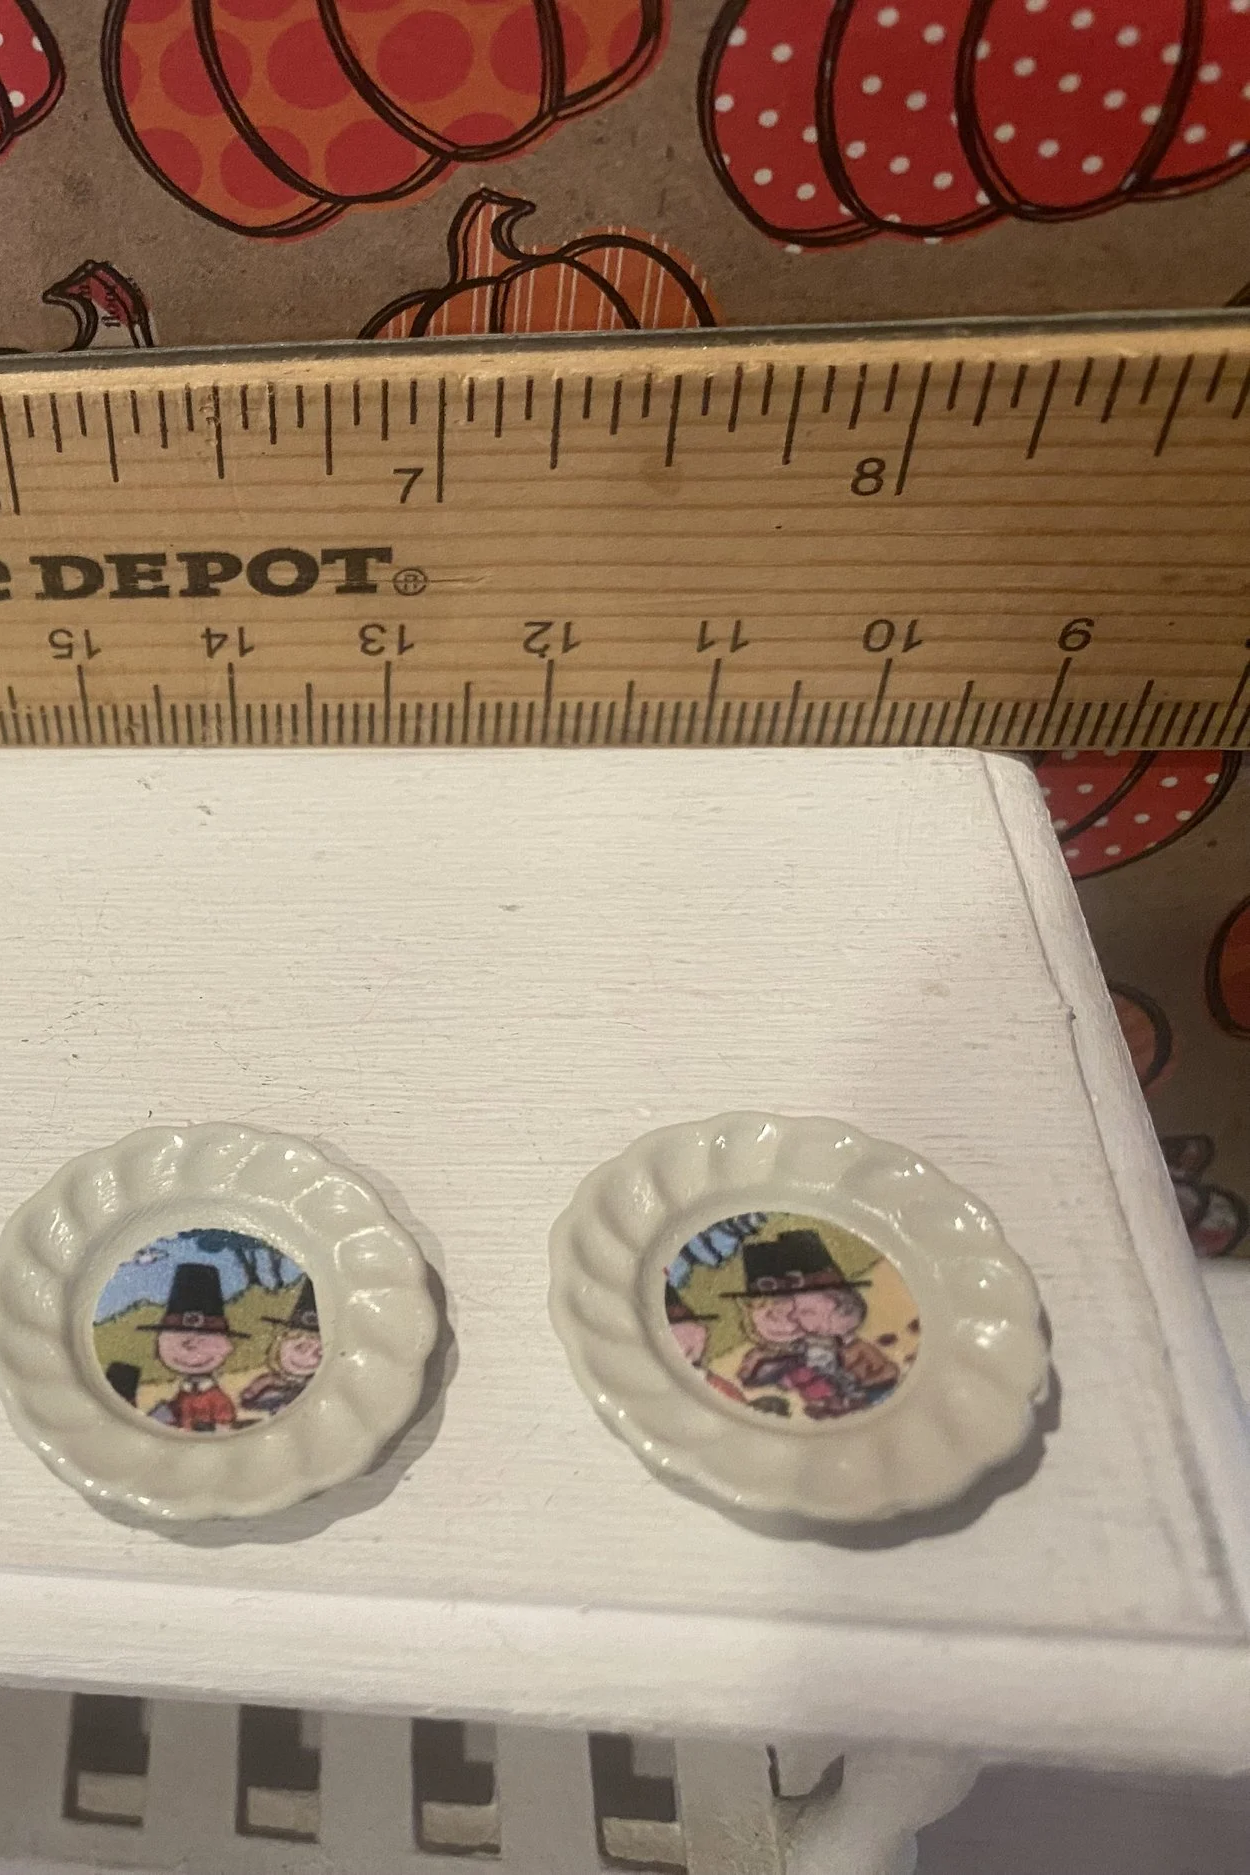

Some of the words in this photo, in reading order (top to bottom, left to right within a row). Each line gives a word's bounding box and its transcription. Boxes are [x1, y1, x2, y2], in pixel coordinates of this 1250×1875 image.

[392, 467, 424, 504] 7
[850, 456, 887, 496] 8
[29, 546, 393, 600] DEPOT
[48, 627, 101, 661] 15
[200, 625, 255, 659] 14
[358, 623, 415, 657] 13
[523, 620, 580, 658] 12
[696, 619, 749, 654] 11
[862, 618, 924, 653] 10
[1057, 617, 1095, 652] 9
